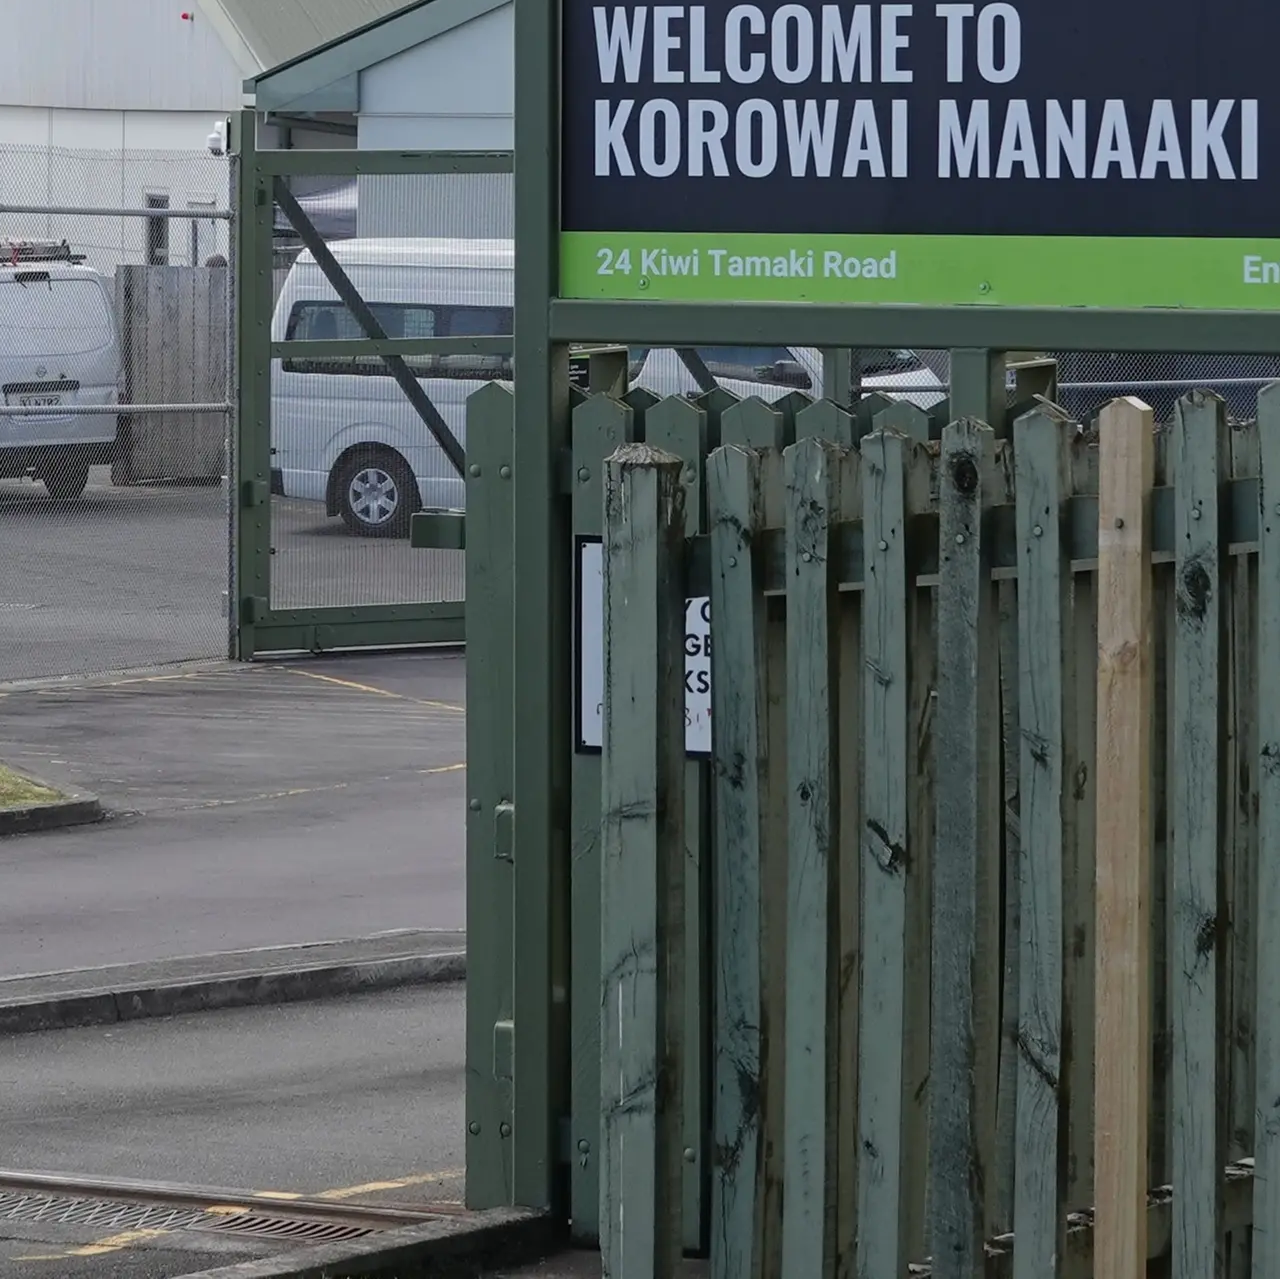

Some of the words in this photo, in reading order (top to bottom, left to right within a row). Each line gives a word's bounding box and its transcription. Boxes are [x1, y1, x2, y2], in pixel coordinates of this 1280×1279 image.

[593, 4, 913, 84] WELCOME
[935, 2, 1021, 84] TO
[594, 99, 908, 178] KOROWAI
[937, 98, 1258, 180] MANAAKI
[596, 248, 632, 275] 24
[640, 248, 699, 276] Kiwi
[707, 249, 814, 278] Tamaki
[823, 250, 897, 279] Road
